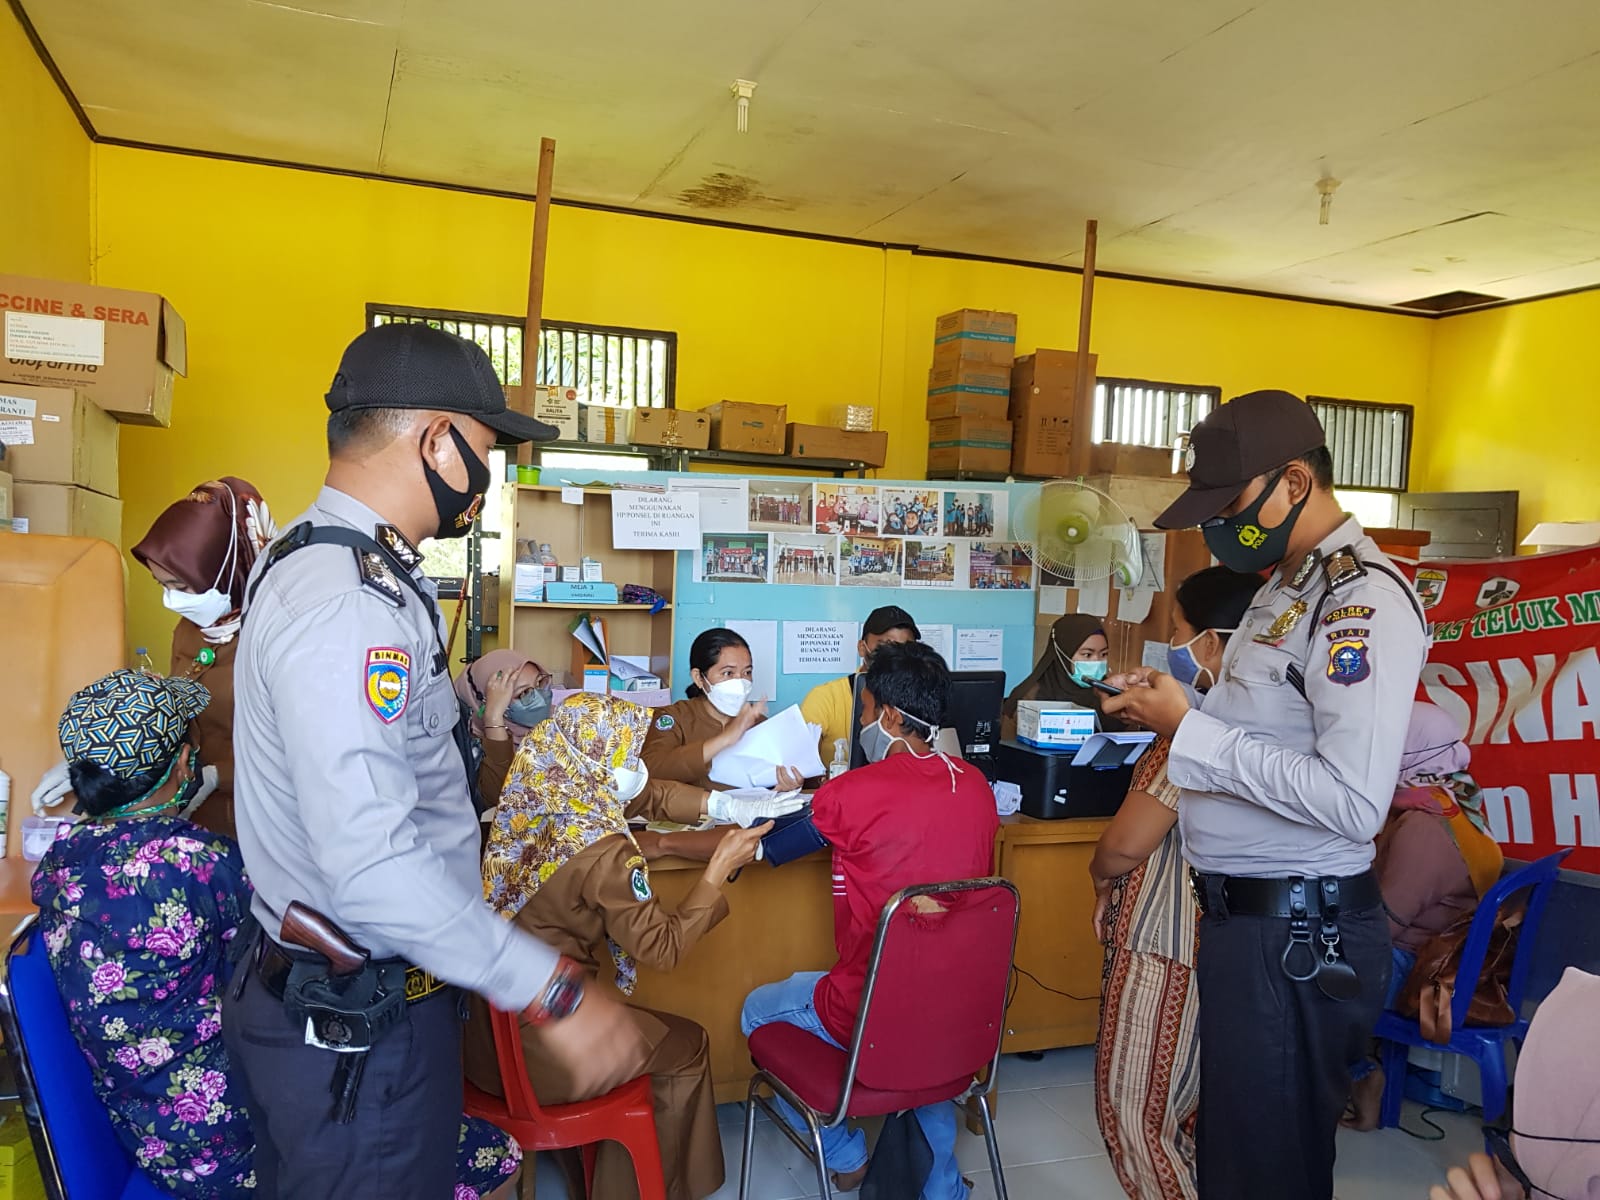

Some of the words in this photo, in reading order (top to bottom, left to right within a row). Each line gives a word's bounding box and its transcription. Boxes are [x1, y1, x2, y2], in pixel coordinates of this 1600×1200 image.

[70, 303, 86, 318] &
[93, 306, 149, 326] SERA
[1326, 606, 1370, 622] POLRES
[1472, 598, 1566, 638] TELUK
[1566, 591, 1600, 624] M
[1330, 629, 1365, 639] RIAU
[375, 651, 408, 665] BINMAS
